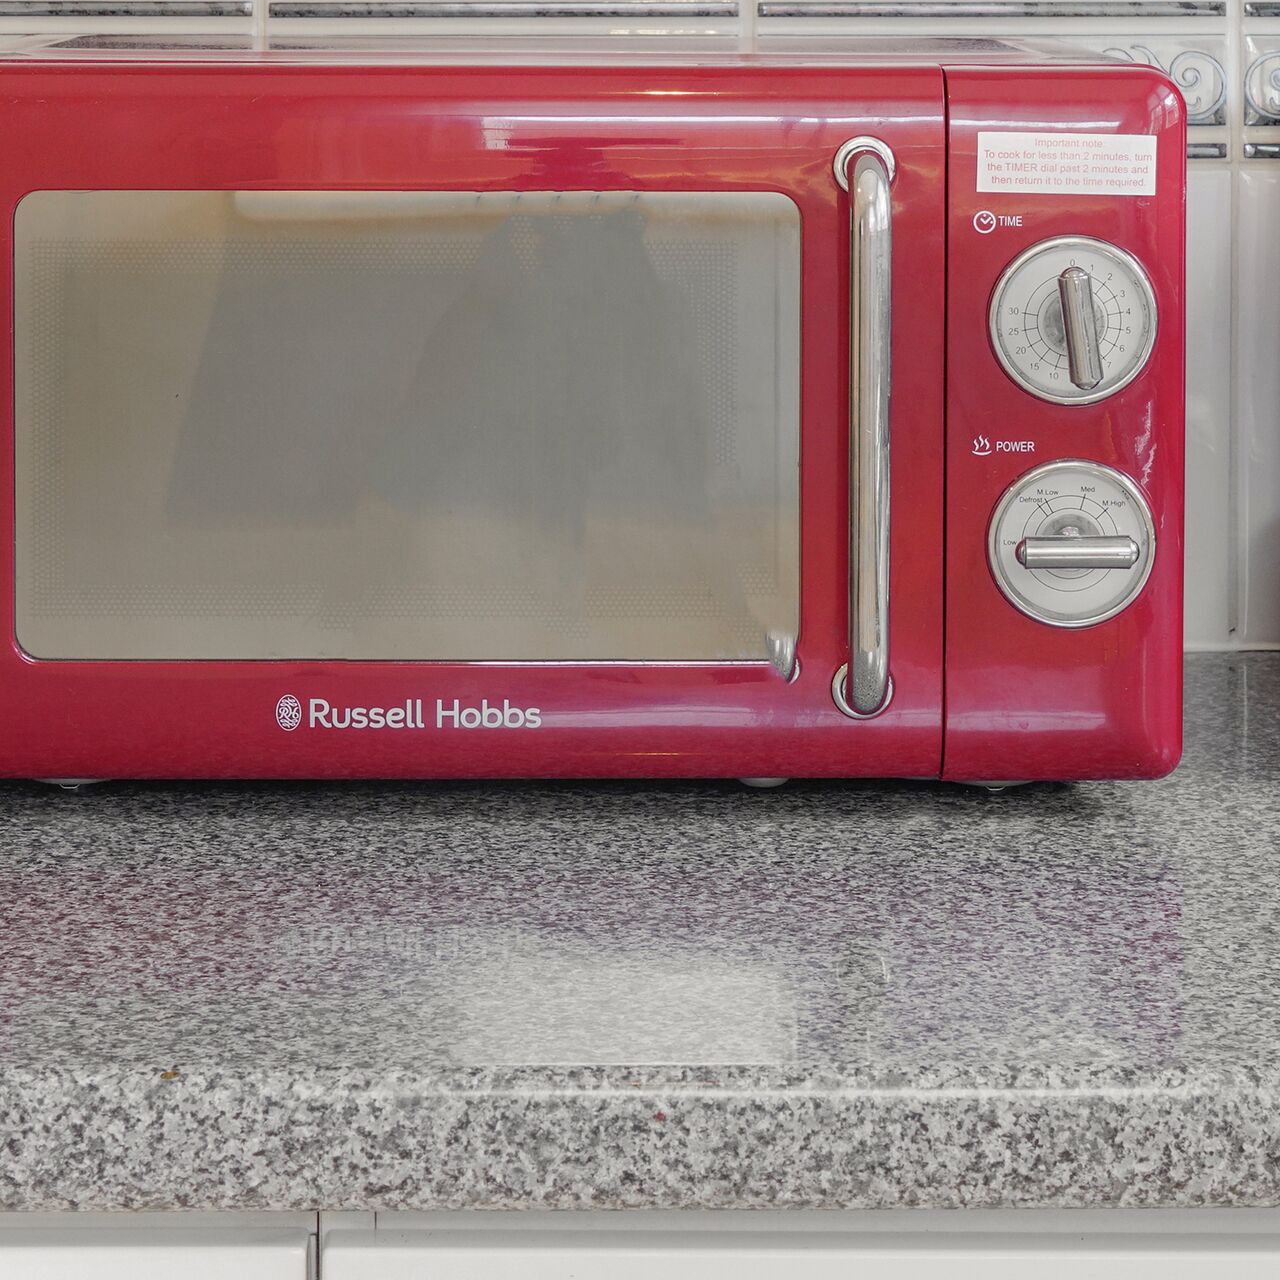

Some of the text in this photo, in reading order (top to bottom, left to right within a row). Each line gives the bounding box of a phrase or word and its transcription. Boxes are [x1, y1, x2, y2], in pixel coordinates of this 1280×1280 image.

[1034, 138, 1104, 149] Important note
[984, 149, 995, 159] To
[998, 150, 1021, 159] cook
[1023, 150, 1035, 160] for
[1038, 150, 1057, 160] less
[1060, 151, 1081, 160] than
[1083, 152, 1090, 161] 2
[1092, 152, 1132, 162] minutes,
[987, 162, 1149, 175] the TIMER dial past 2 minutes and
[991, 175, 1146, 188] then return it to the time required.
[998, 216, 1023, 227] TIME
[1008, 307, 1020, 316] 30
[1008, 327, 1020, 336] 25
[1015, 346, 1027, 355] 20
[1030, 362, 1040, 371] 15
[1049, 372, 1059, 380] 10
[996, 441, 1035, 453] POWER
[1019, 496, 1043, 504] Defrost
[309, 698, 425, 729] Russell
[436, 698, 543, 729] Hobbs
